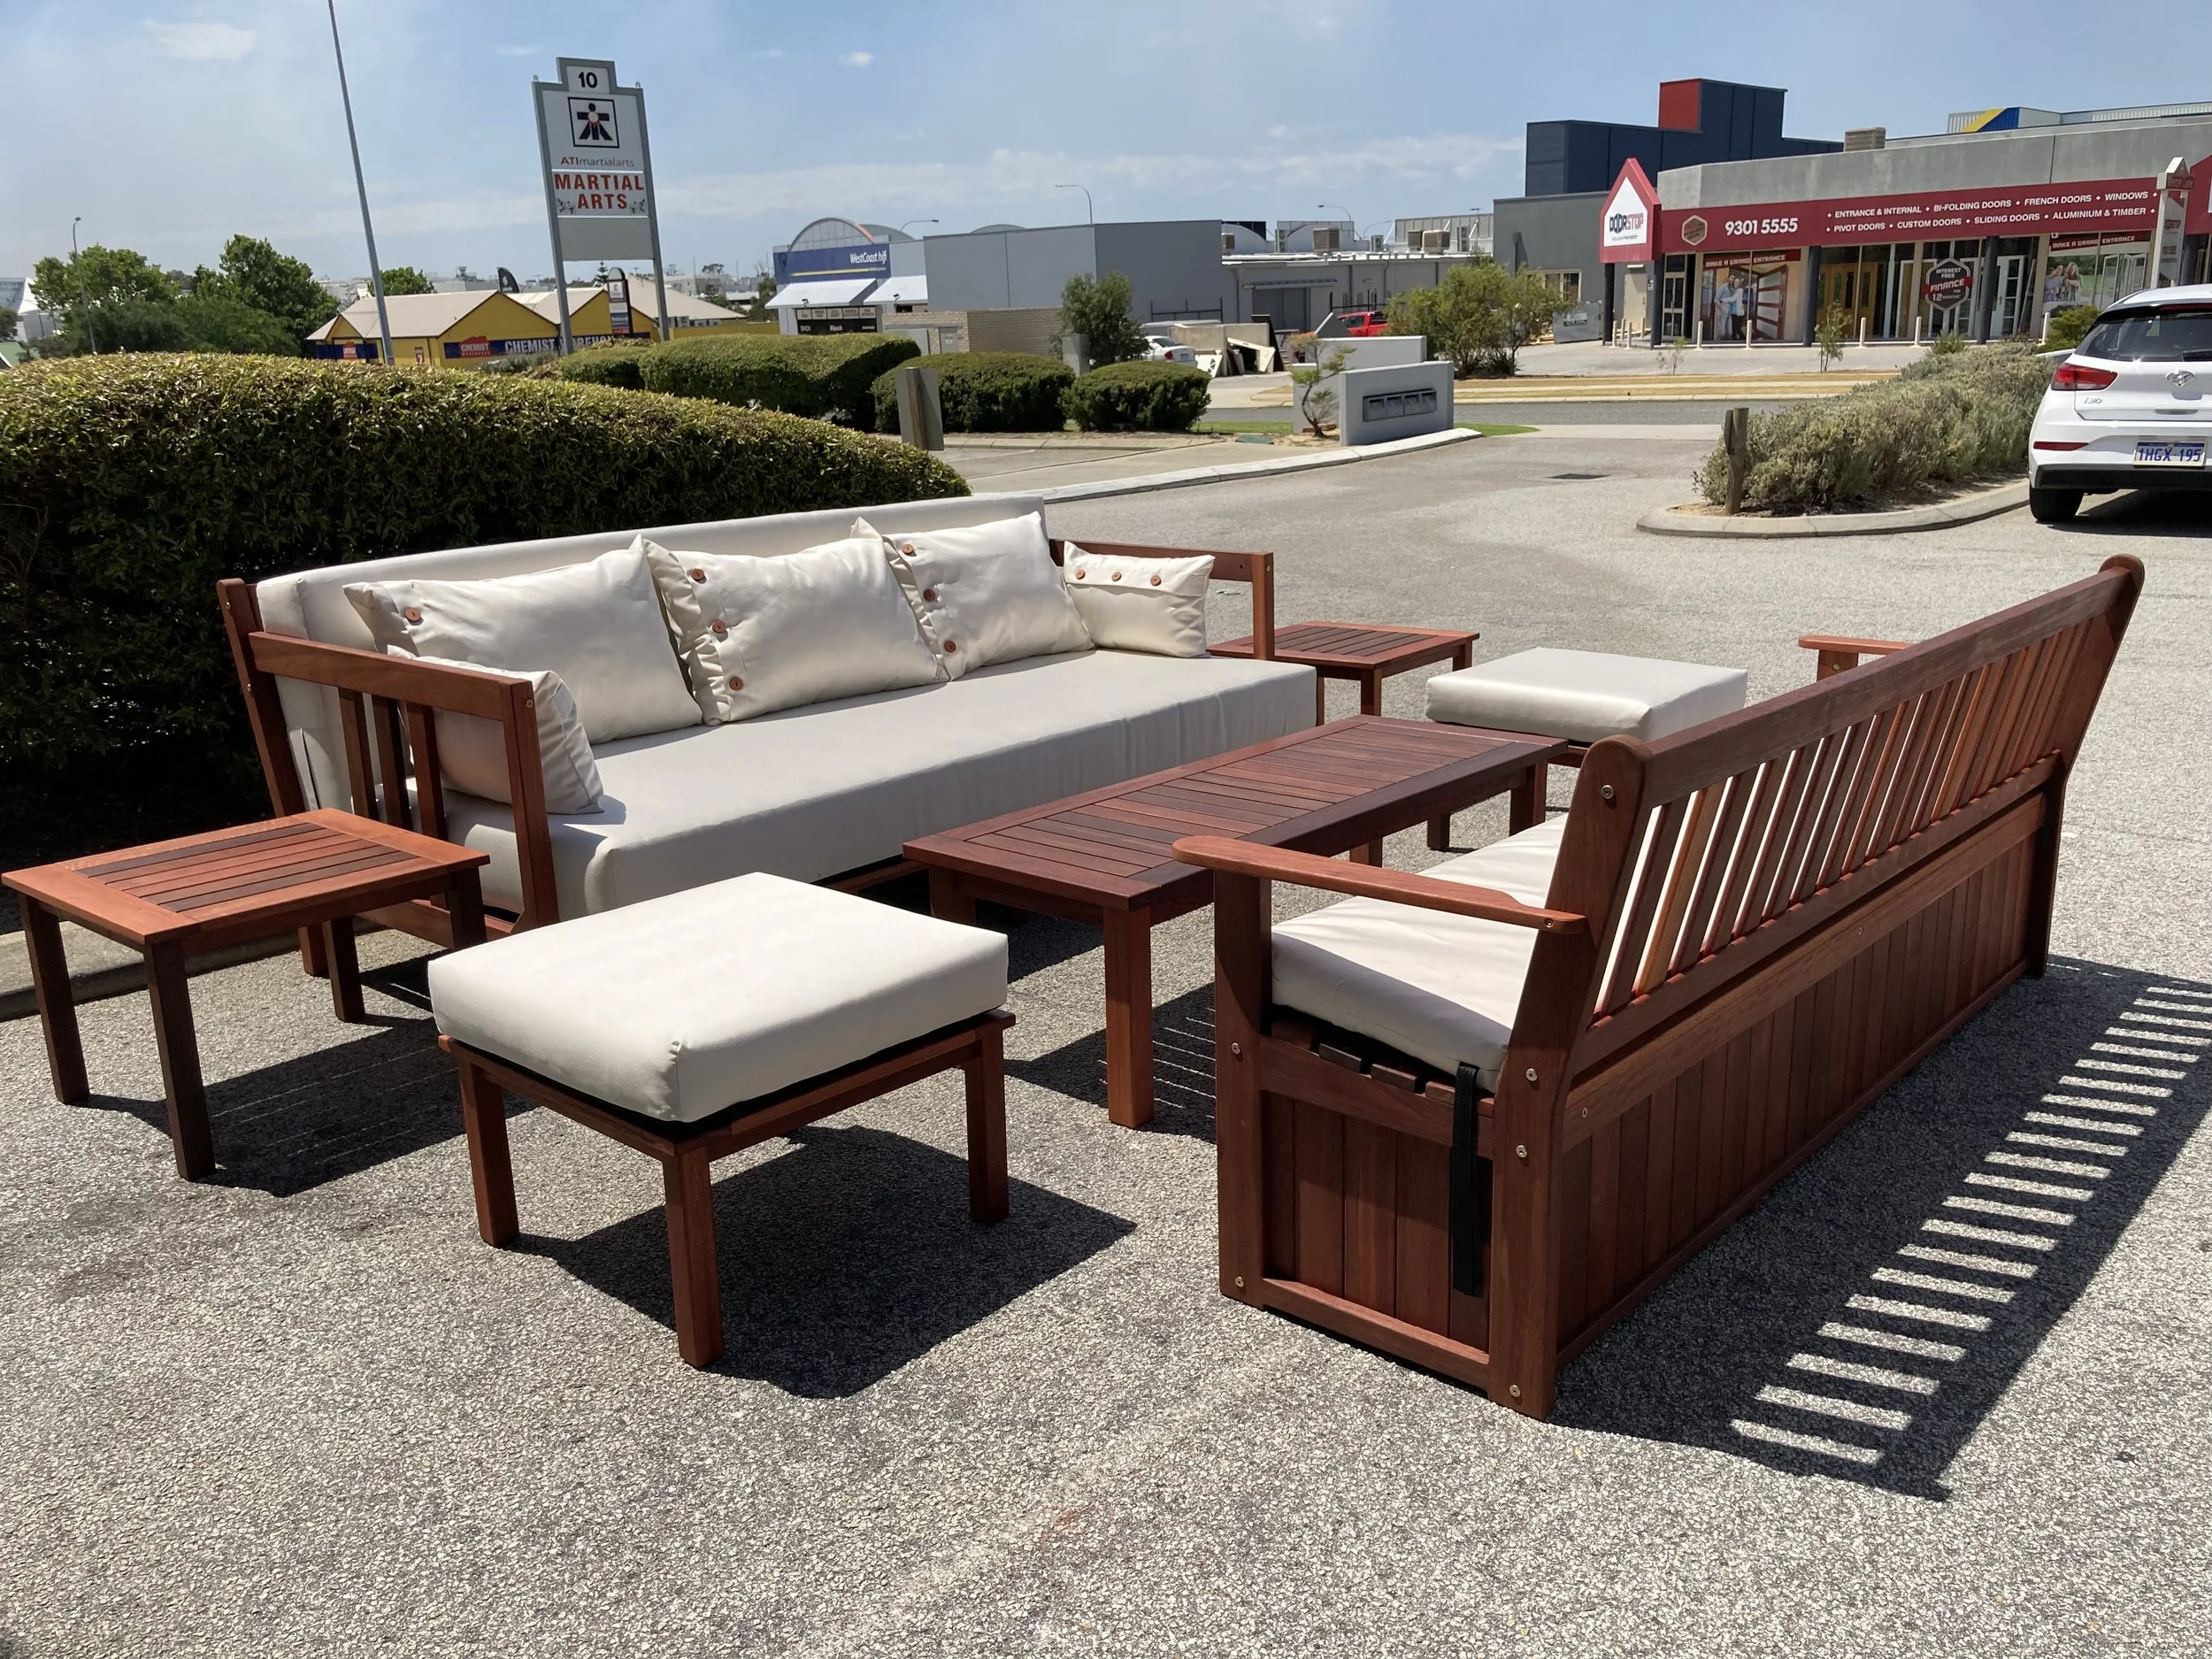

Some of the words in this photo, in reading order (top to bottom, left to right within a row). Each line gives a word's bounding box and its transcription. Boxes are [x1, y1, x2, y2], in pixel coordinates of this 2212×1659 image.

[578, 72, 598, 88] 10
[554, 173, 645, 191] MARTIAL
[577, 193, 627, 210] ARTS
[2024, 196, 2059, 206] FRENCH
[2061, 195, 2092, 204] DOORS
[2105, 191, 2148, 201] WINDOWS
[1933, 202, 1980, 212] BI-FOLDING
[1981, 199, 2012, 209] DOORS
[1834, 209, 1875, 219] ENTRANCE
[1884, 205, 1922, 215] INTERNAL
[2053, 210, 2102, 219] ALUMINIUM
[2112, 207, 2147, 217] TIMBER
[1897, 220, 1932, 229] CUSTOM
[1932, 218, 1962, 227] DOORS
[1974, 215, 2008, 224] SLIDING
[2009, 213, 2040, 222] DOORS
[1724, 219, 1759, 235] 9301
[1761, 218, 1799, 234] 5555
[1833, 224, 1856, 233] PIVOT
[1858, 223, 1886, 232] DOORS
[2101, 235, 2136, 244] ENTRANCE
[1753, 254, 1786, 264] ENTRANCE
[1930, 278, 1965, 292] FINANCE
[1932, 293, 1942, 302] 12
[504, 338, 557, 355] CHEMIST
[2138, 448, 2173, 461] 1HGX
[2179, 449, 2202, 462] 195
